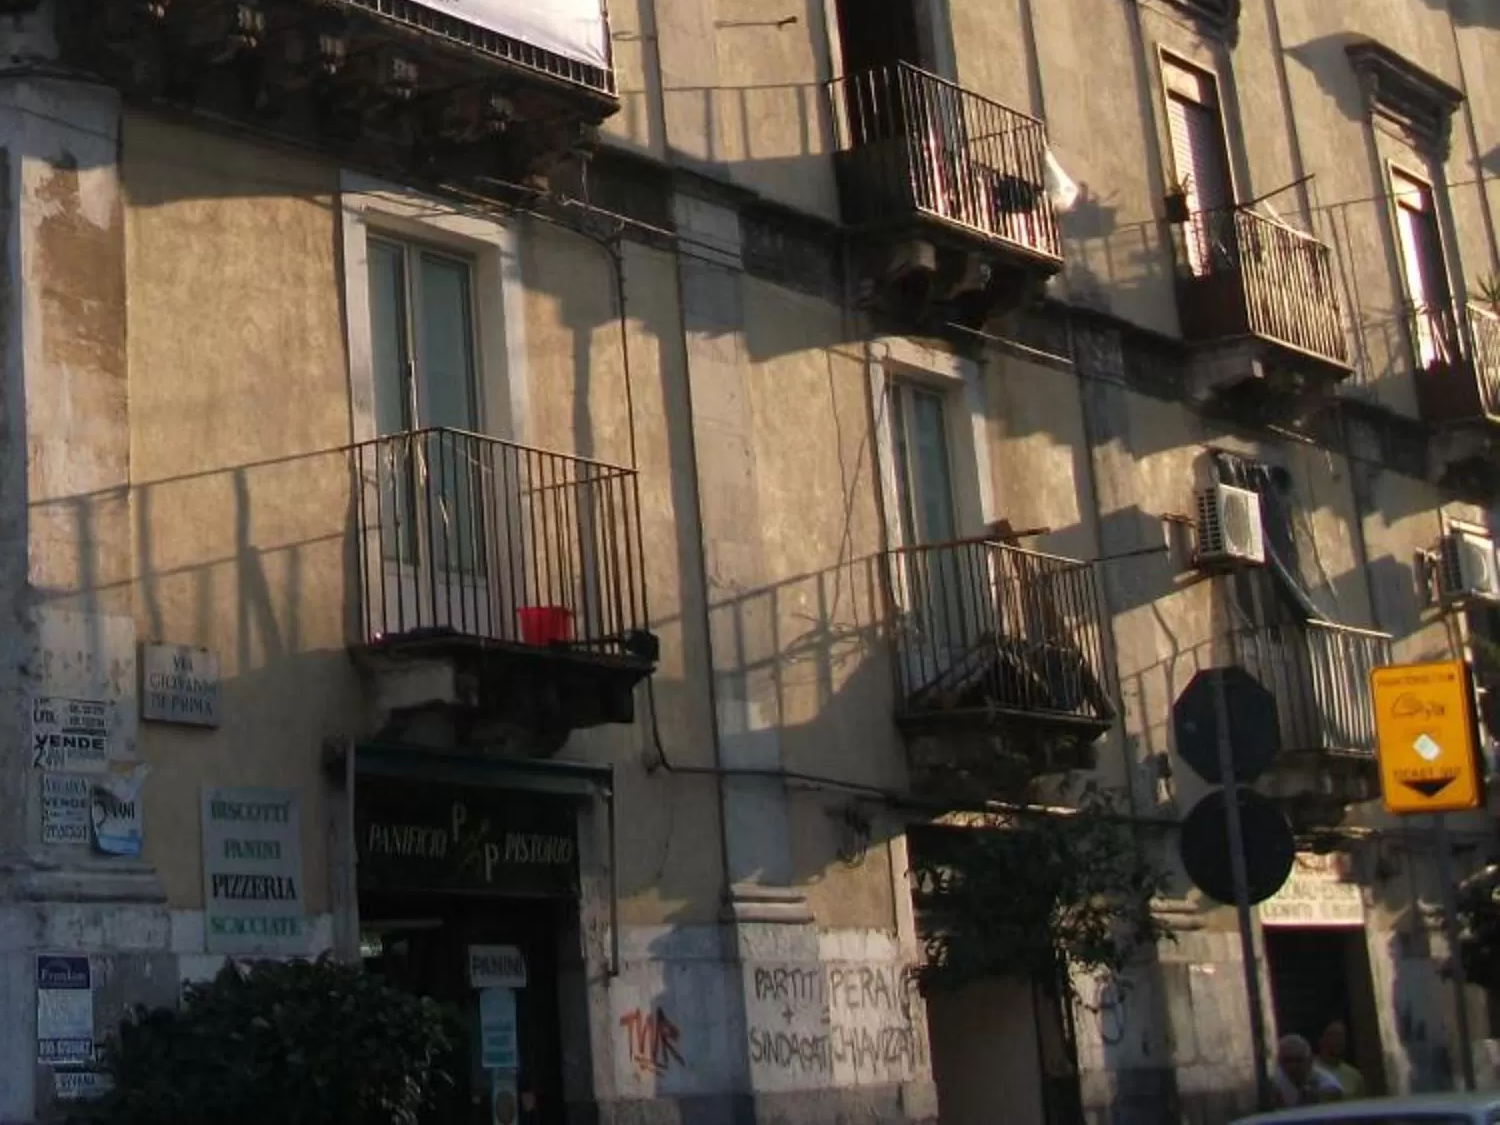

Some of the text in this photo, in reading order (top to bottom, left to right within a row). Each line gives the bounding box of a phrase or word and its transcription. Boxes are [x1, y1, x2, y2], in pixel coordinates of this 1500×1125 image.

[35, 734, 105, 750] VENDE
[211, 800, 290, 823] BISCOTTI
[211, 872, 297, 900] PIZZERIA
